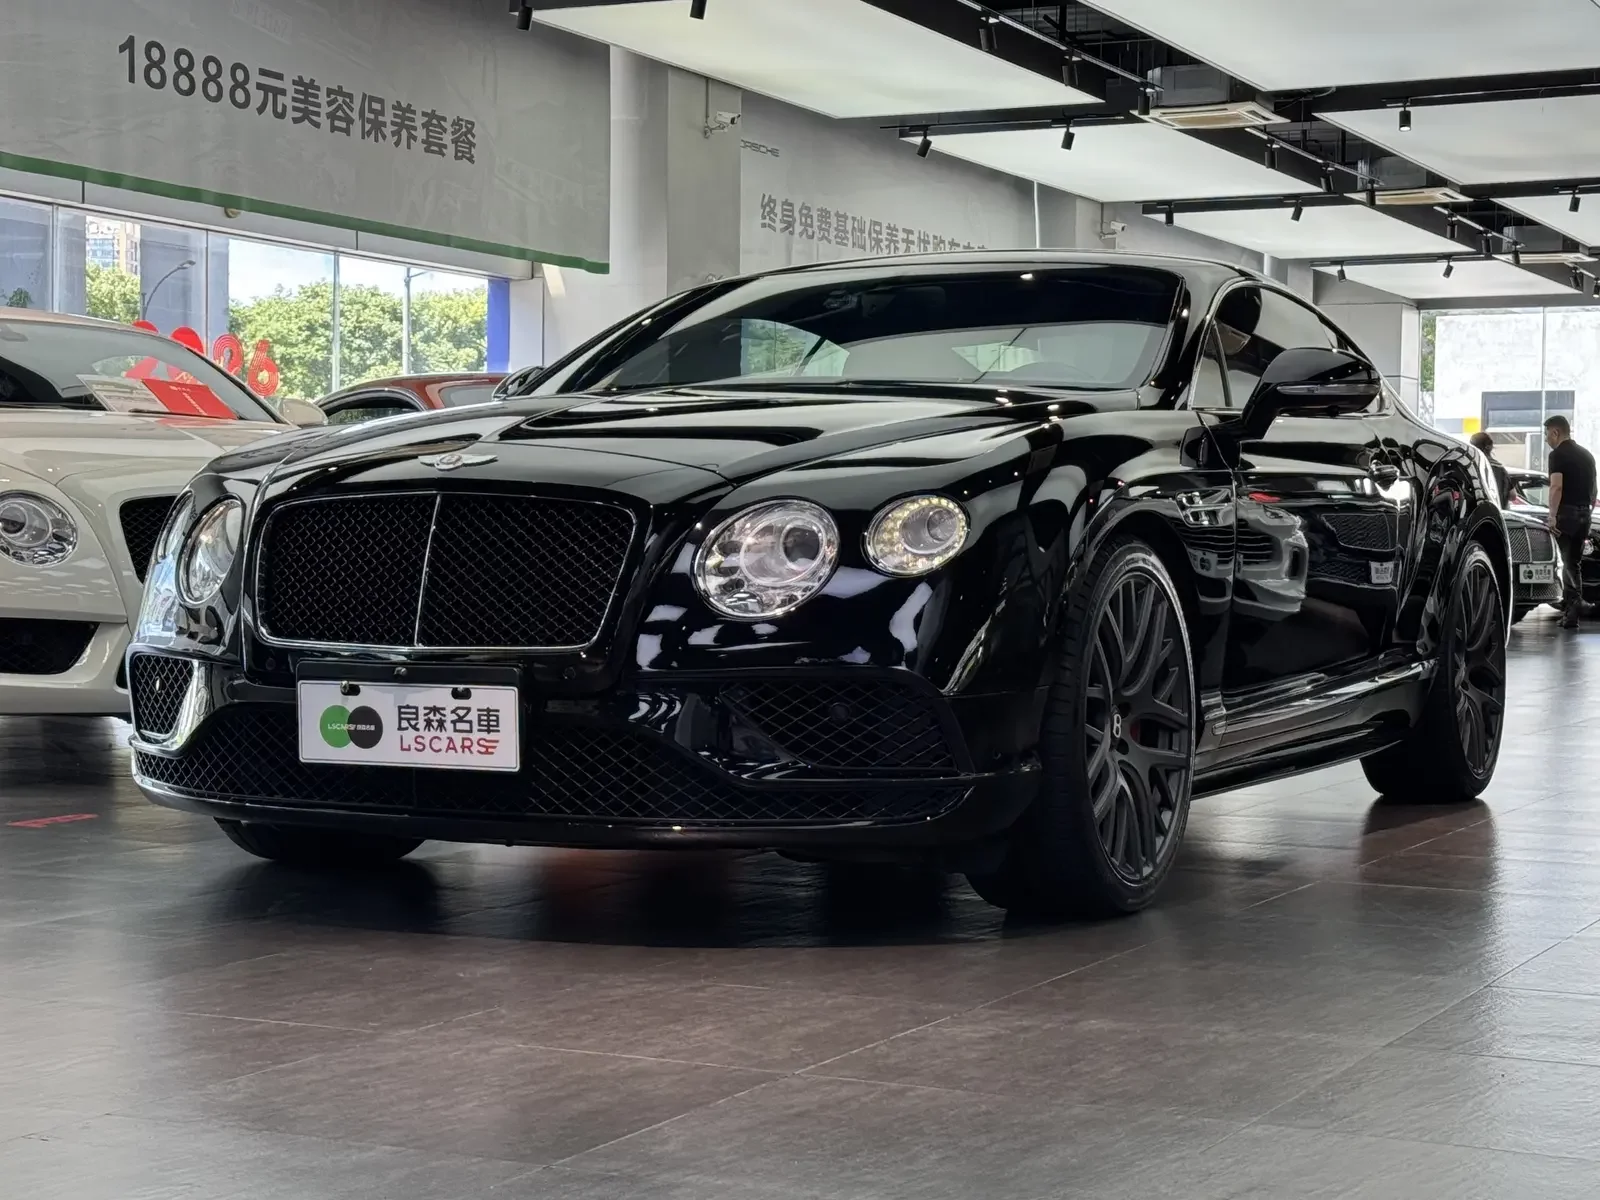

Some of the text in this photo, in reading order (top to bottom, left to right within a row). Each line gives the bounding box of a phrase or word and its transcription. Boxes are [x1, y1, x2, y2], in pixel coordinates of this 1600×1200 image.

[118, 34, 477, 165] 18888元美容保养套餐
[760, 192, 988, 255] 终身免费基础保养无忧购
[397, 703, 500, 735] 良森名車
[399, 735, 500, 755] LSCARS
